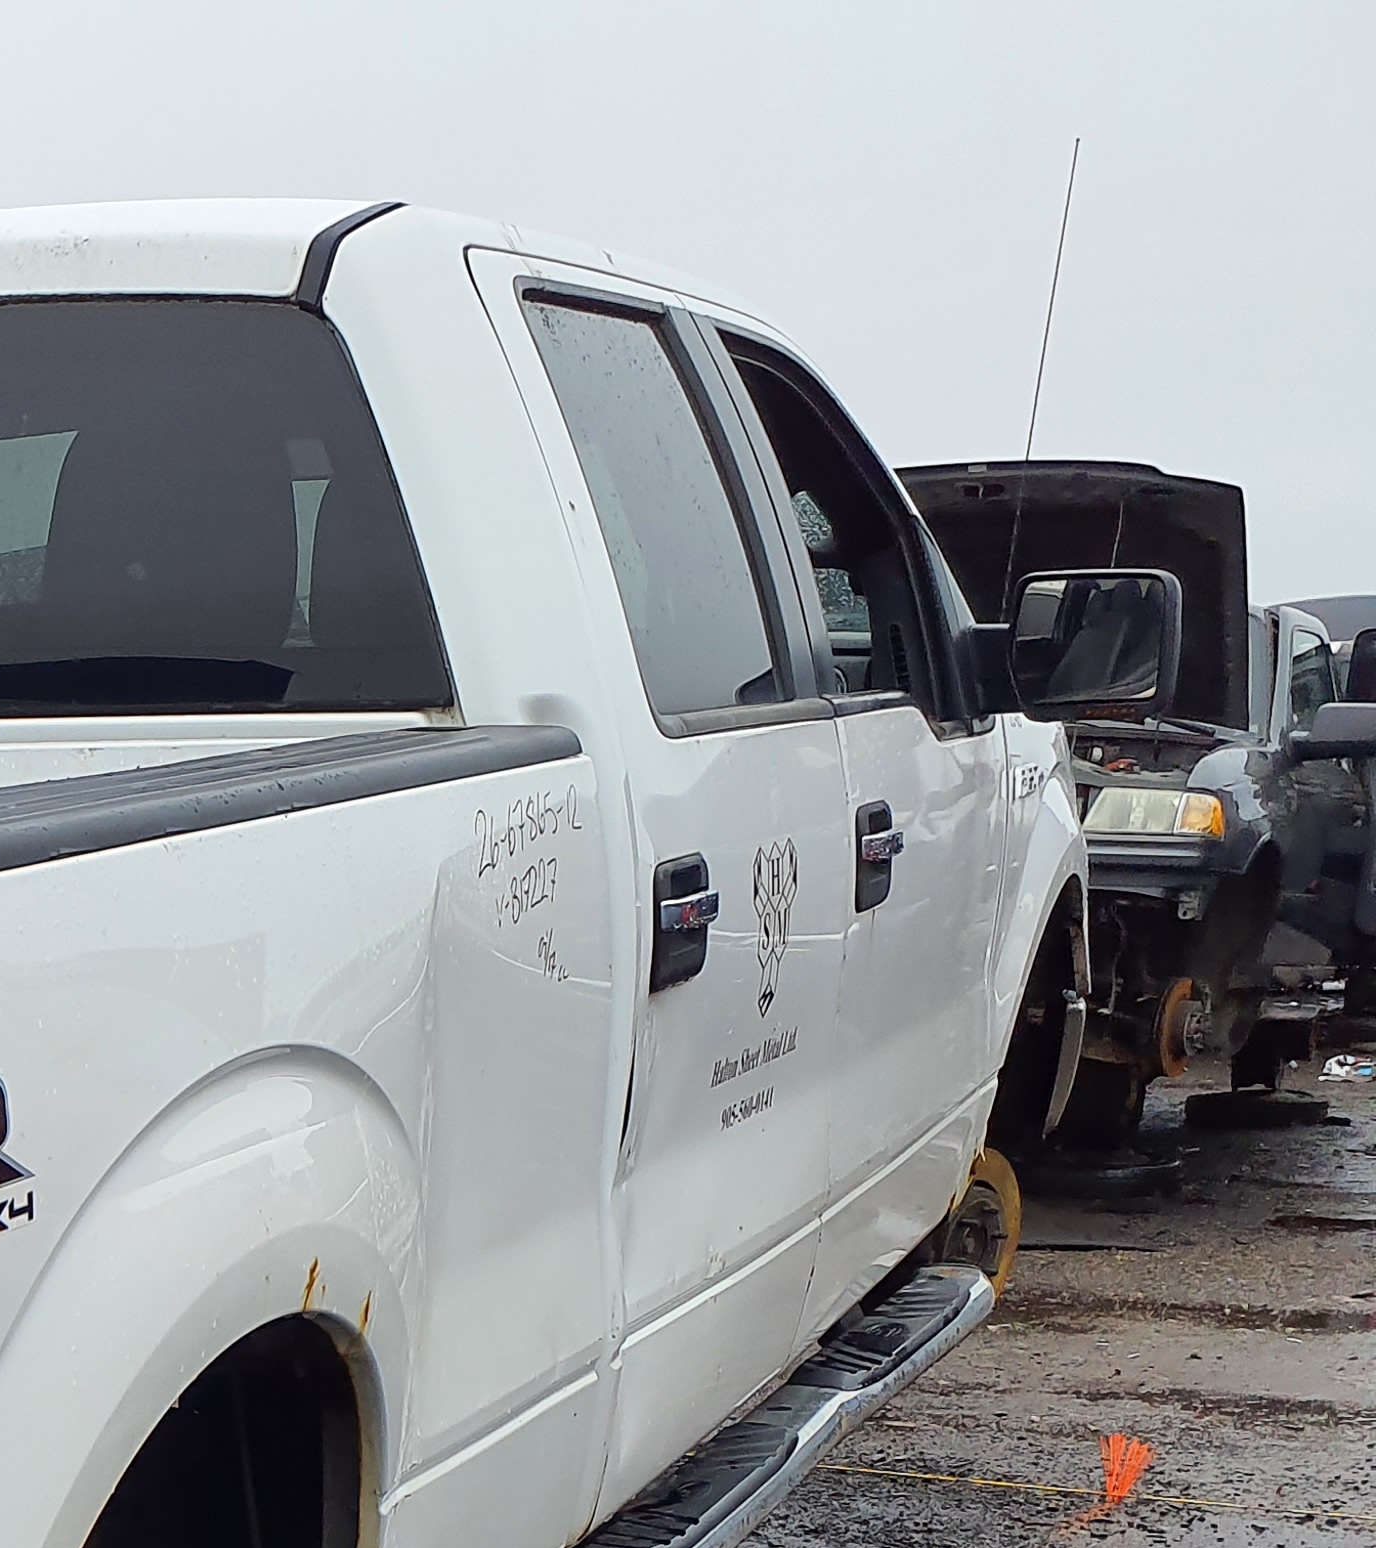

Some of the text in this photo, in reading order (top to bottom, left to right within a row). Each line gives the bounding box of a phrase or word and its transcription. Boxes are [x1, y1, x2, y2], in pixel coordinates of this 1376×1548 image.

[770, 857, 781, 897] H
[762, 906, 788, 951] S M
